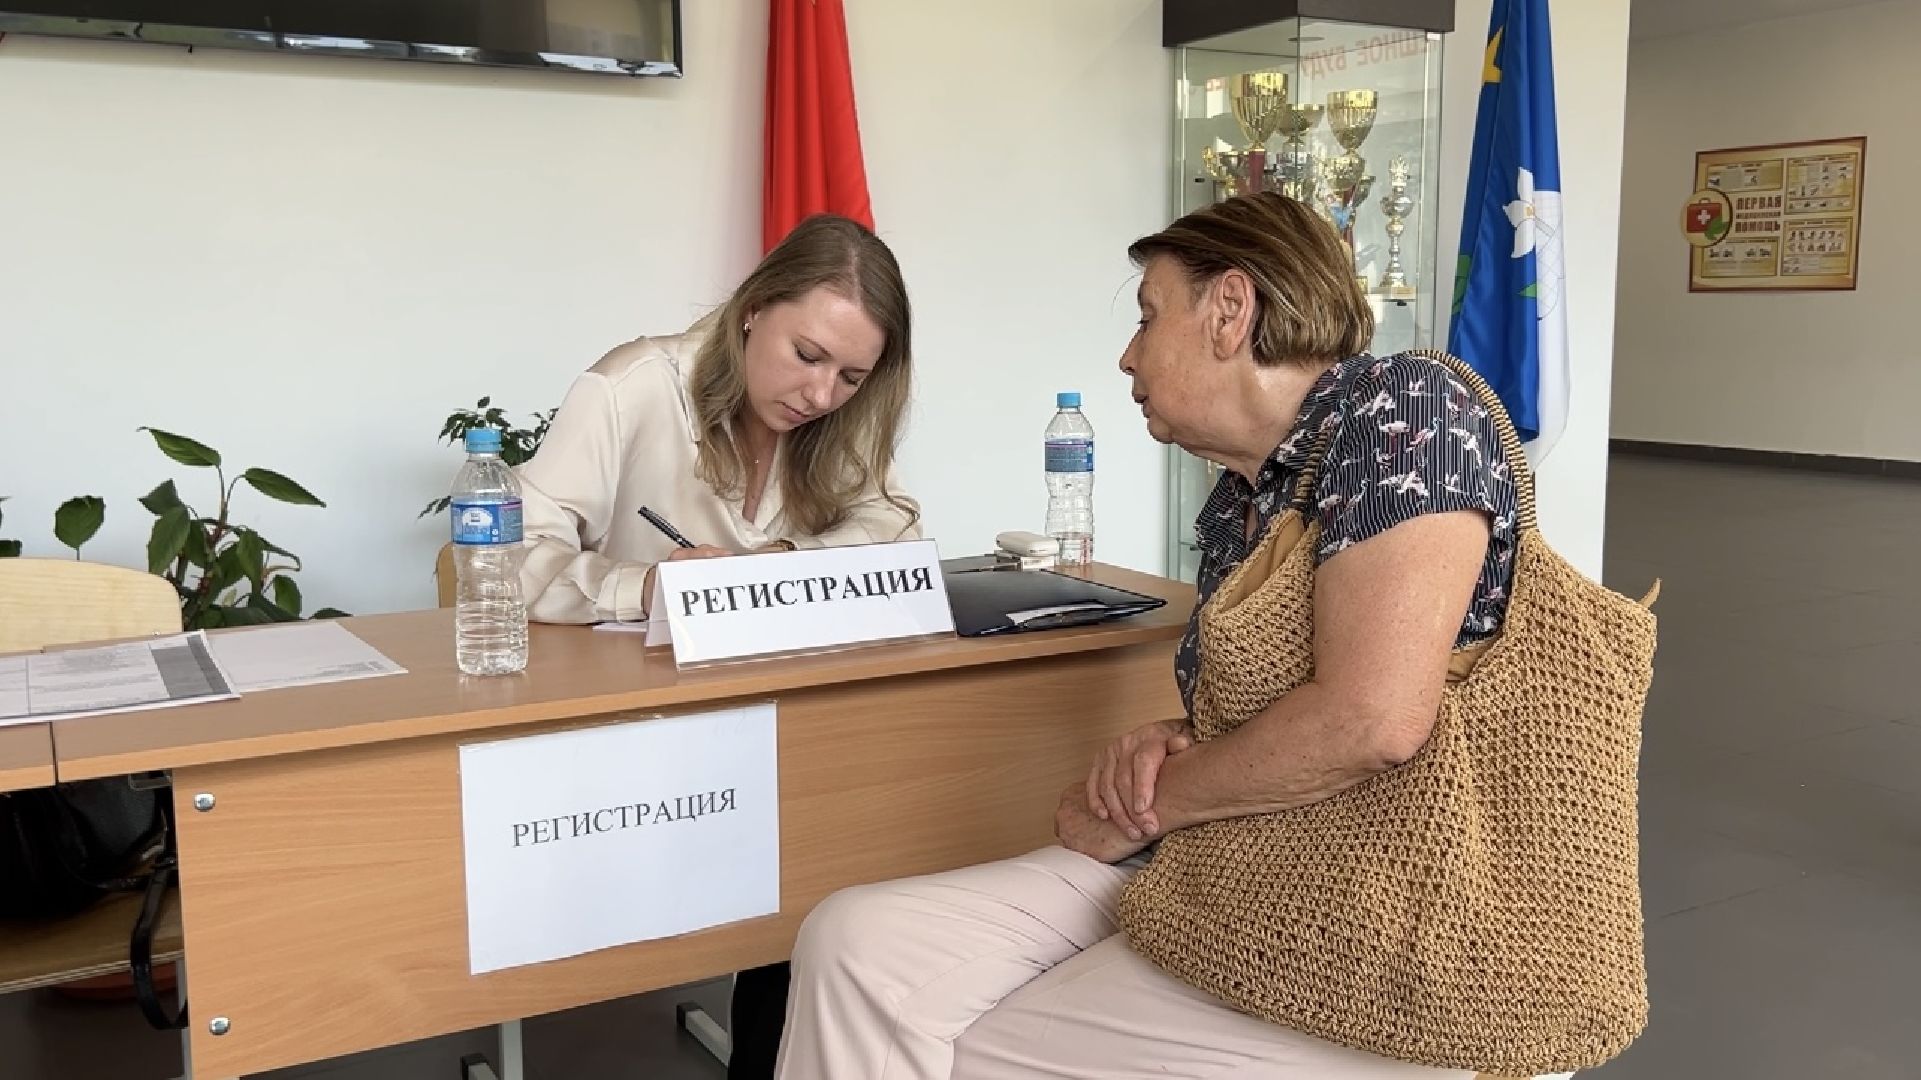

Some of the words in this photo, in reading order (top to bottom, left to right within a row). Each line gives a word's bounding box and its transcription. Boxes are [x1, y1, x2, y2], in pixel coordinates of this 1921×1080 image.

[1736, 196, 1782, 210] ПЕРВАЯ
[680, 567, 934, 617] РЕГИСТРАЦИЯ
[512, 788, 737, 848] РЕГИСТРАЦИЯ
